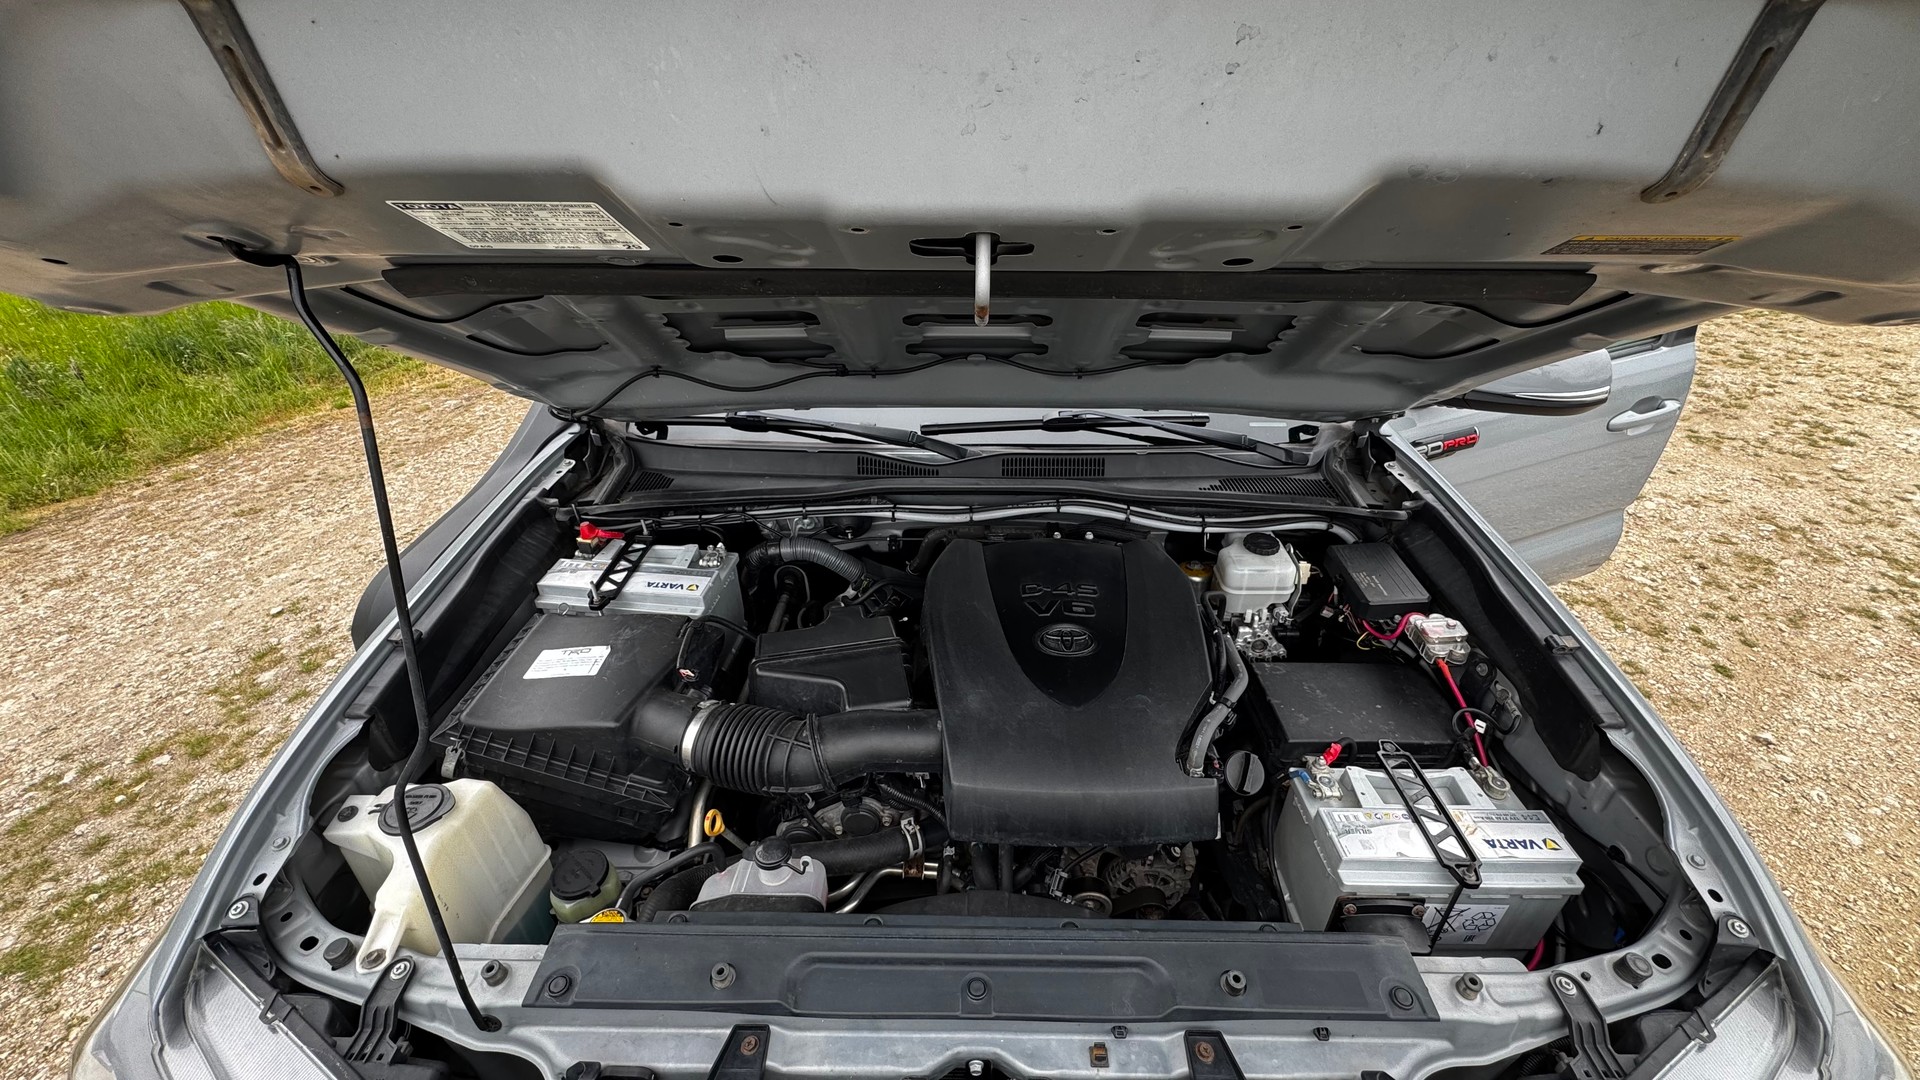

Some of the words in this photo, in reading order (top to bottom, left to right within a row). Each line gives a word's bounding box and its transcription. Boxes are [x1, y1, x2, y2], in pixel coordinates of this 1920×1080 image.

[647, 581, 684, 590] VARTA
[1020, 583, 1100, 598] D-4S
[1024, 600, 1097, 618] V6
[561, 648, 592, 656] TRD
[1482, 838, 1544, 850] VARTA
